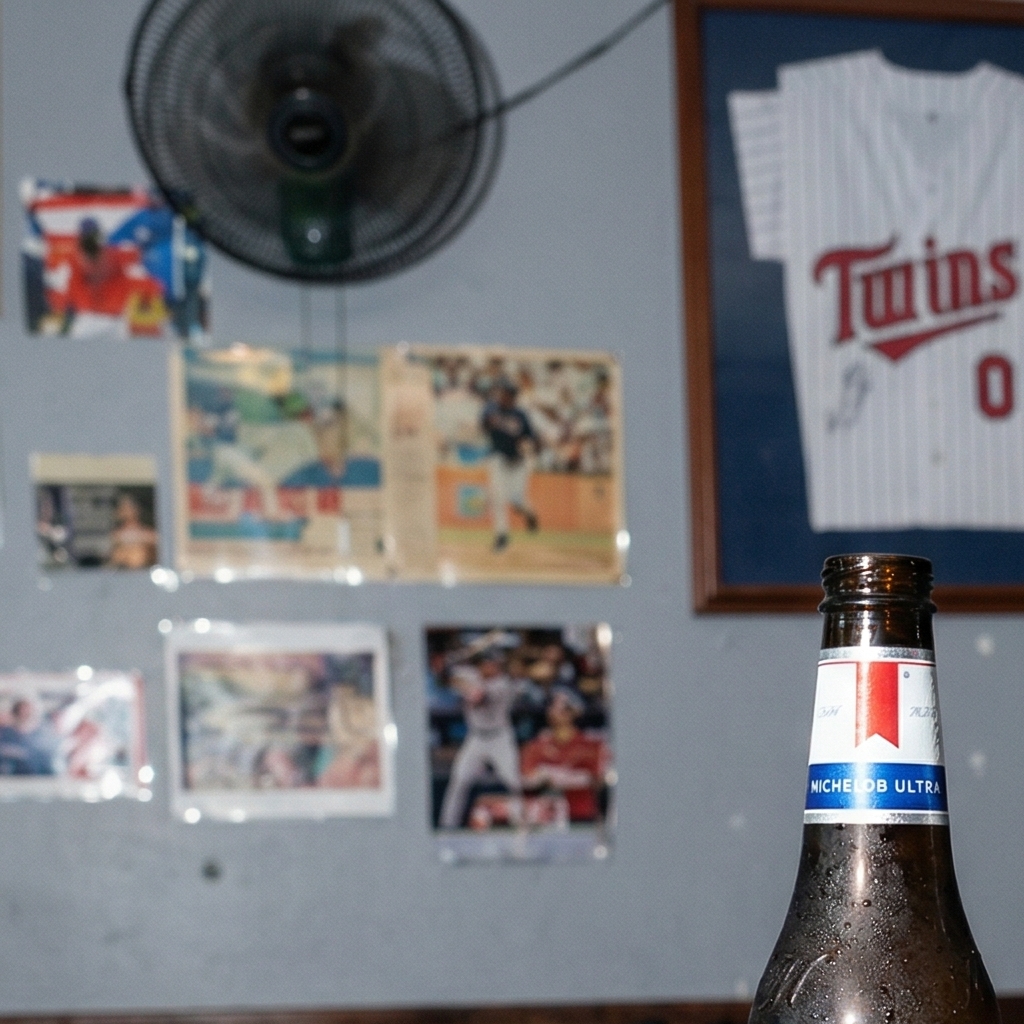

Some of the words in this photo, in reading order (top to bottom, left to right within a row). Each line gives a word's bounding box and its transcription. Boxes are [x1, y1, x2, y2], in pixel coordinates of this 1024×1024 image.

[812, 235, 1019, 346] Twins
[976, 354, 1014, 420] 0
[811, 778, 888, 794] MICHELOB
[894, 779, 941, 794] ULTRA
